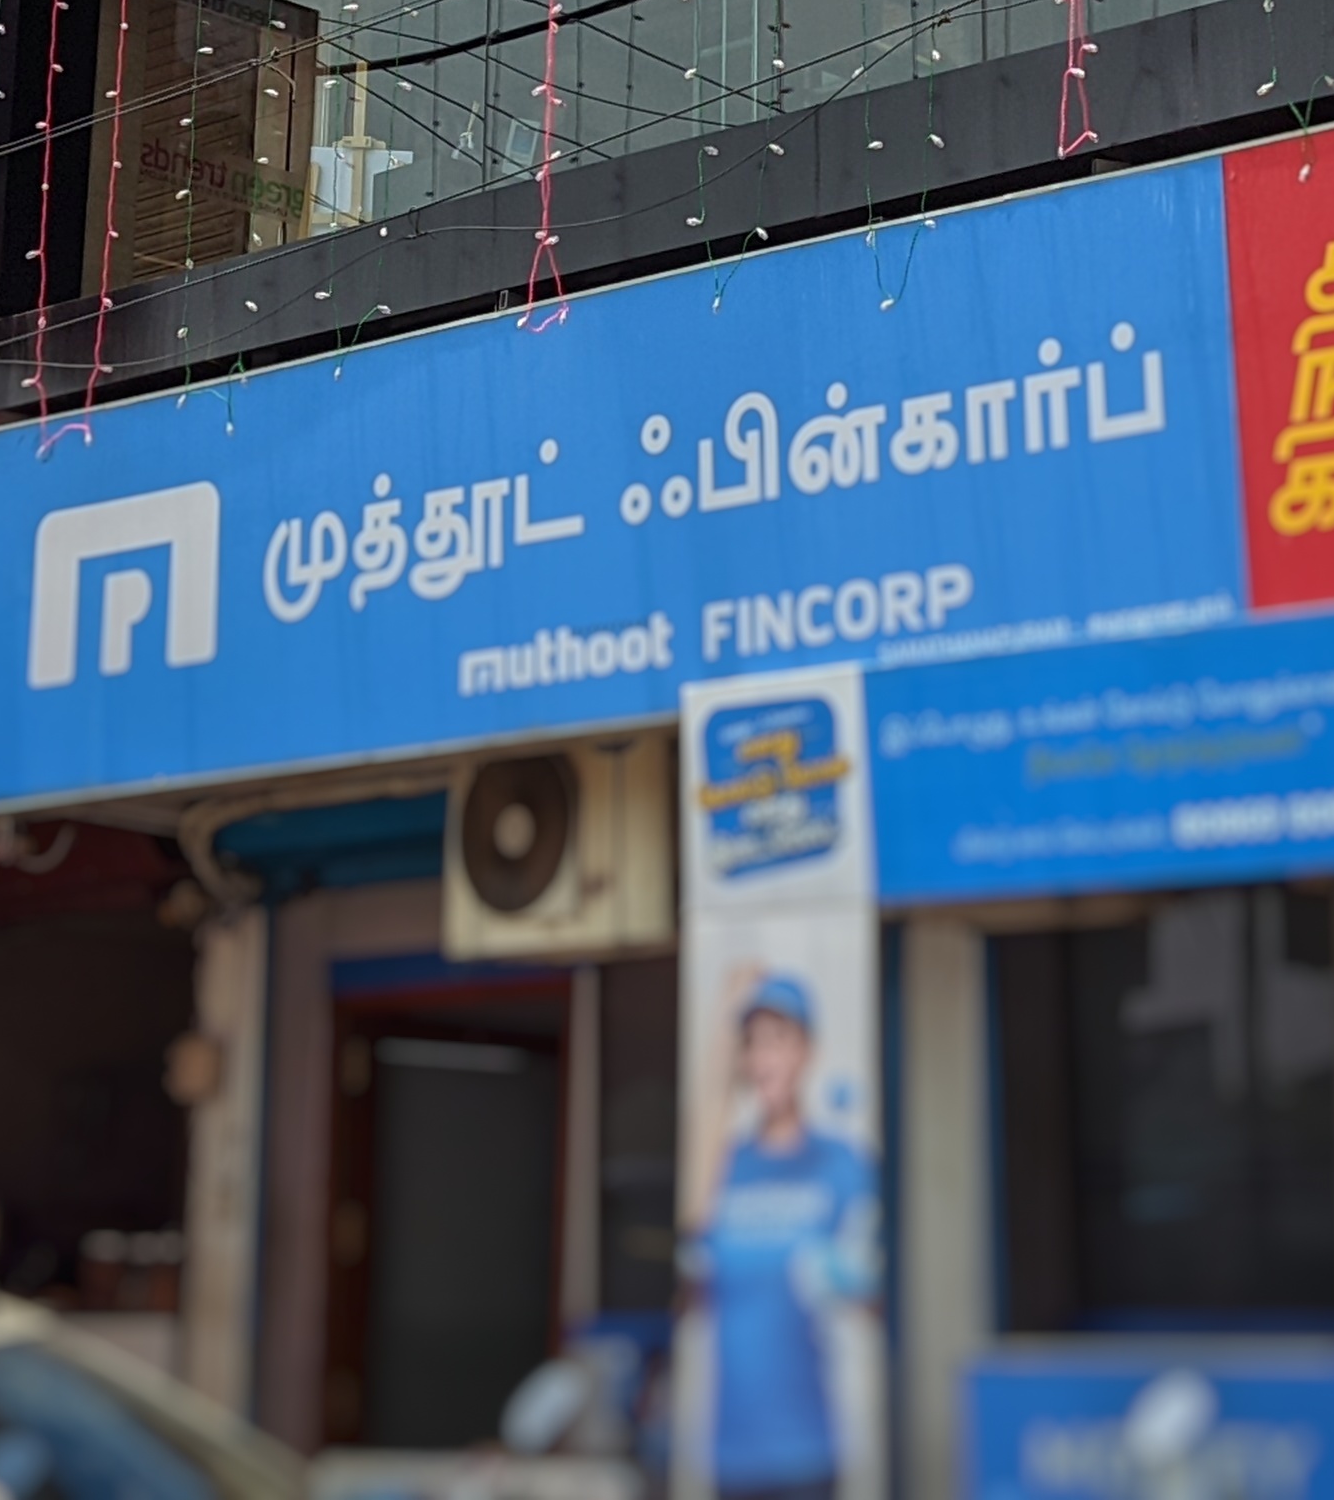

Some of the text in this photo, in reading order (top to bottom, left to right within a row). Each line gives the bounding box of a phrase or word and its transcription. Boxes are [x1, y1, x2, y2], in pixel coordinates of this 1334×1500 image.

[263, 320, 1167, 624] முத்தூட் ஃபின்கார்ப்
[458, 612, 673, 698] muthoot
[701, 564, 975, 664] FINCORP
